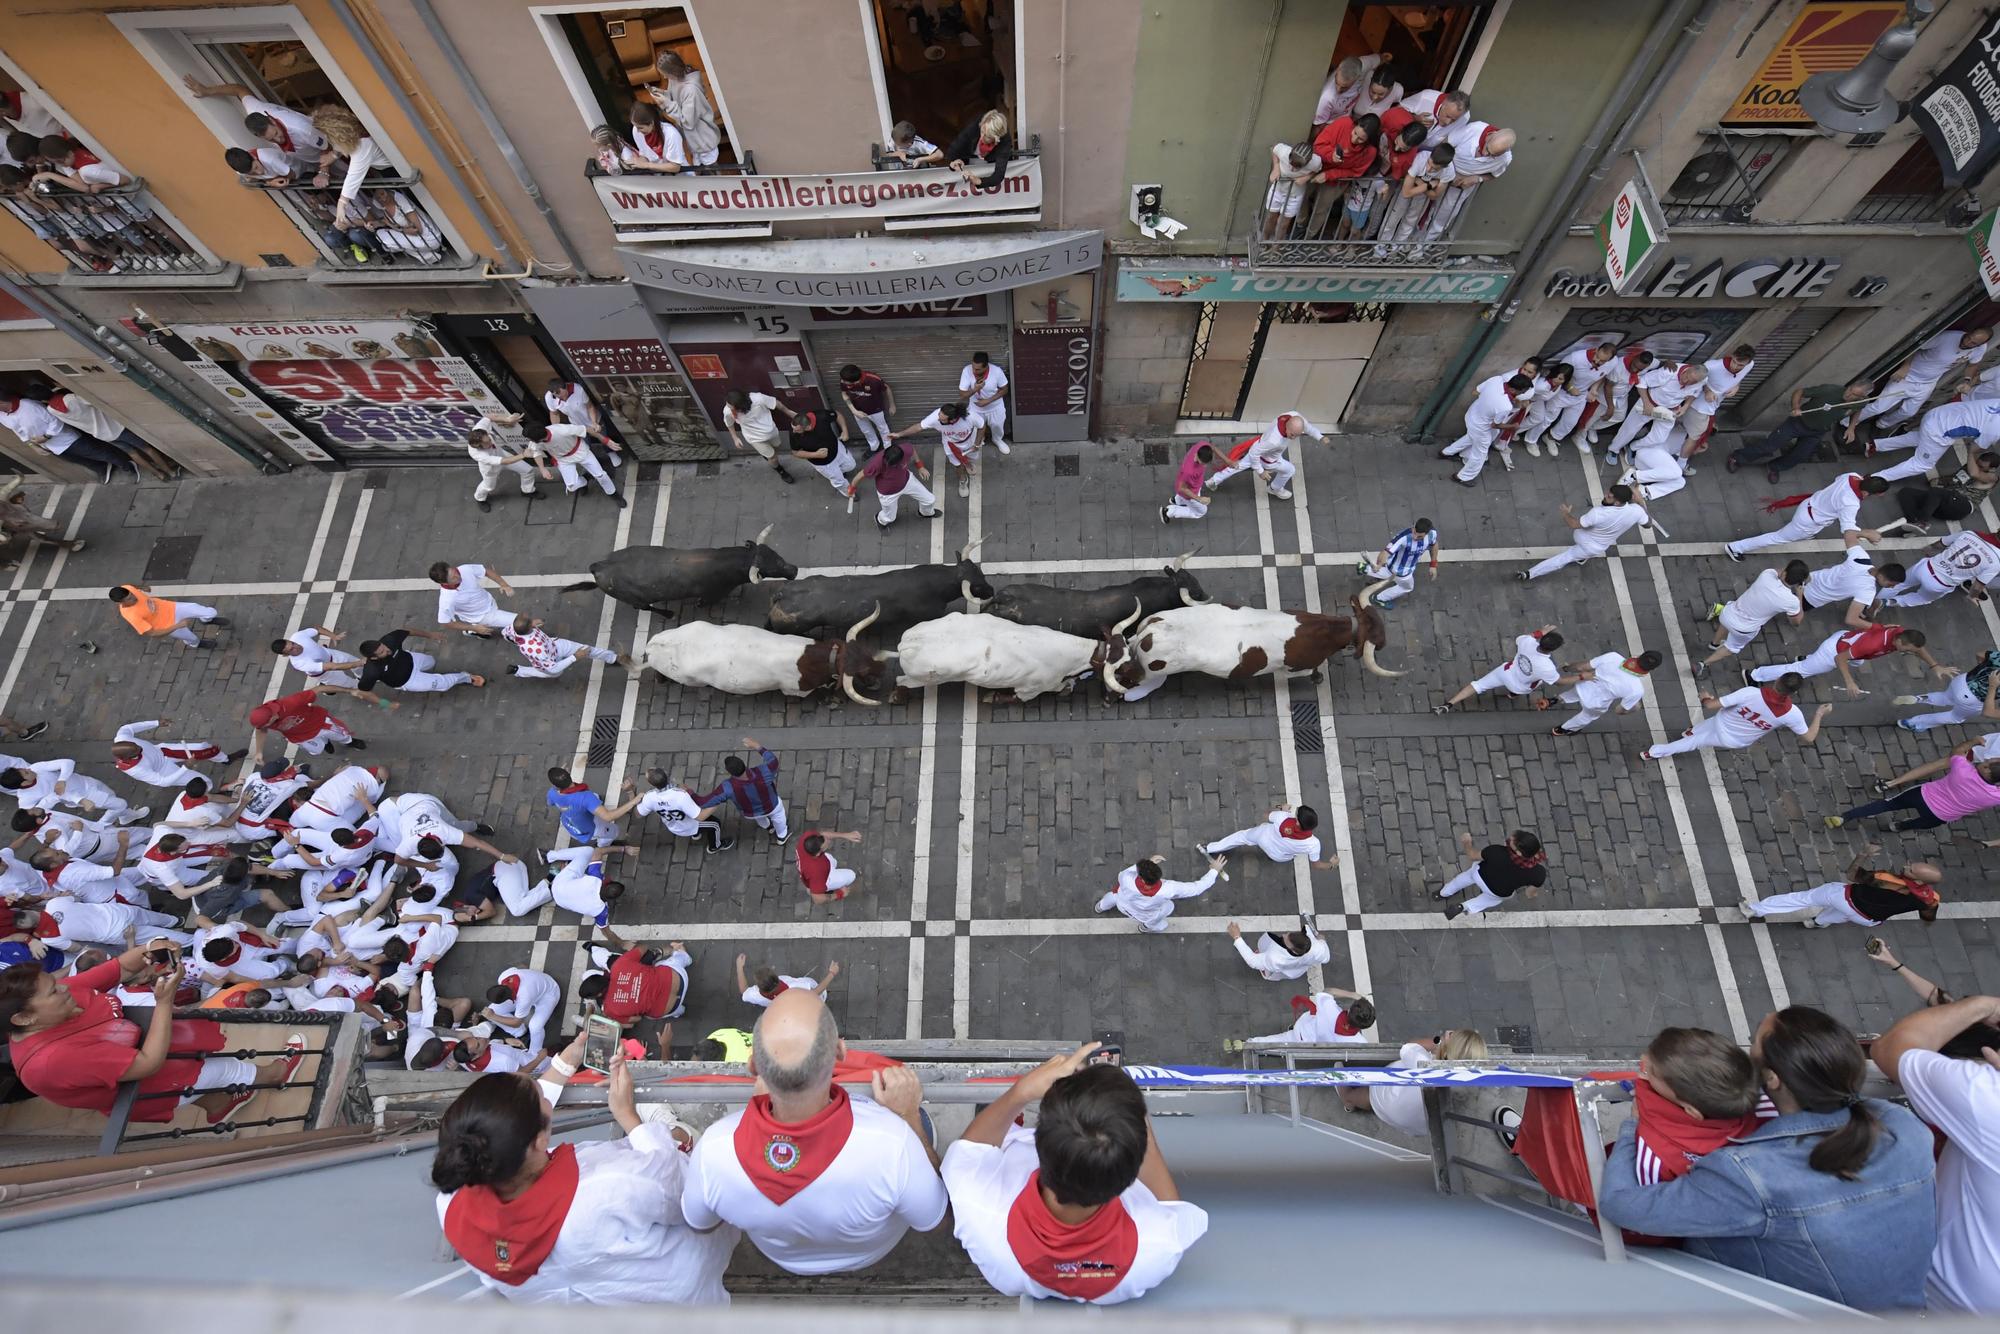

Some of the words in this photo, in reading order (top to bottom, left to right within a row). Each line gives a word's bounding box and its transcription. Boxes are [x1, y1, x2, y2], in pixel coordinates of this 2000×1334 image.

[1742, 84, 1803, 106] Kod
[1938, 96, 1965, 132] LABORATORIO
[1959, 130, 1971, 155] COLOR
[1943, 85, 1965, 107] ESTUDIO
[1960, 103, 1979, 150] FOTOGRAFICO
[1929, 101, 1944, 121] VENTA
[1941, 118, 1951, 131] DE
[1946, 127, 1963, 162] MATERIAL
[611, 173, 1030, 210] www.cuchilleriagomez.com
[633, 261, 663, 281] 15
[672, 268, 768, 294] GOMEZ
[776, 274, 947, 297] CUCHILLERIA
[956, 254, 1052, 285] GOMEZ
[1063, 244, 1090, 265] 15
[1231, 275, 1495, 292] TODOCHINO
[1547, 276, 1610, 298] foto
[230, 325, 359, 336] KEBABISH
[484, 319, 510, 331] 13
[754, 316, 789, 335] 15
[567, 347, 615, 356] fundada
[637, 345, 663, 354] 1943
[575, 355, 667, 363] cuchilleria
[580, 363, 672, 373] regalos
[642, 384, 683, 393] Afilador
